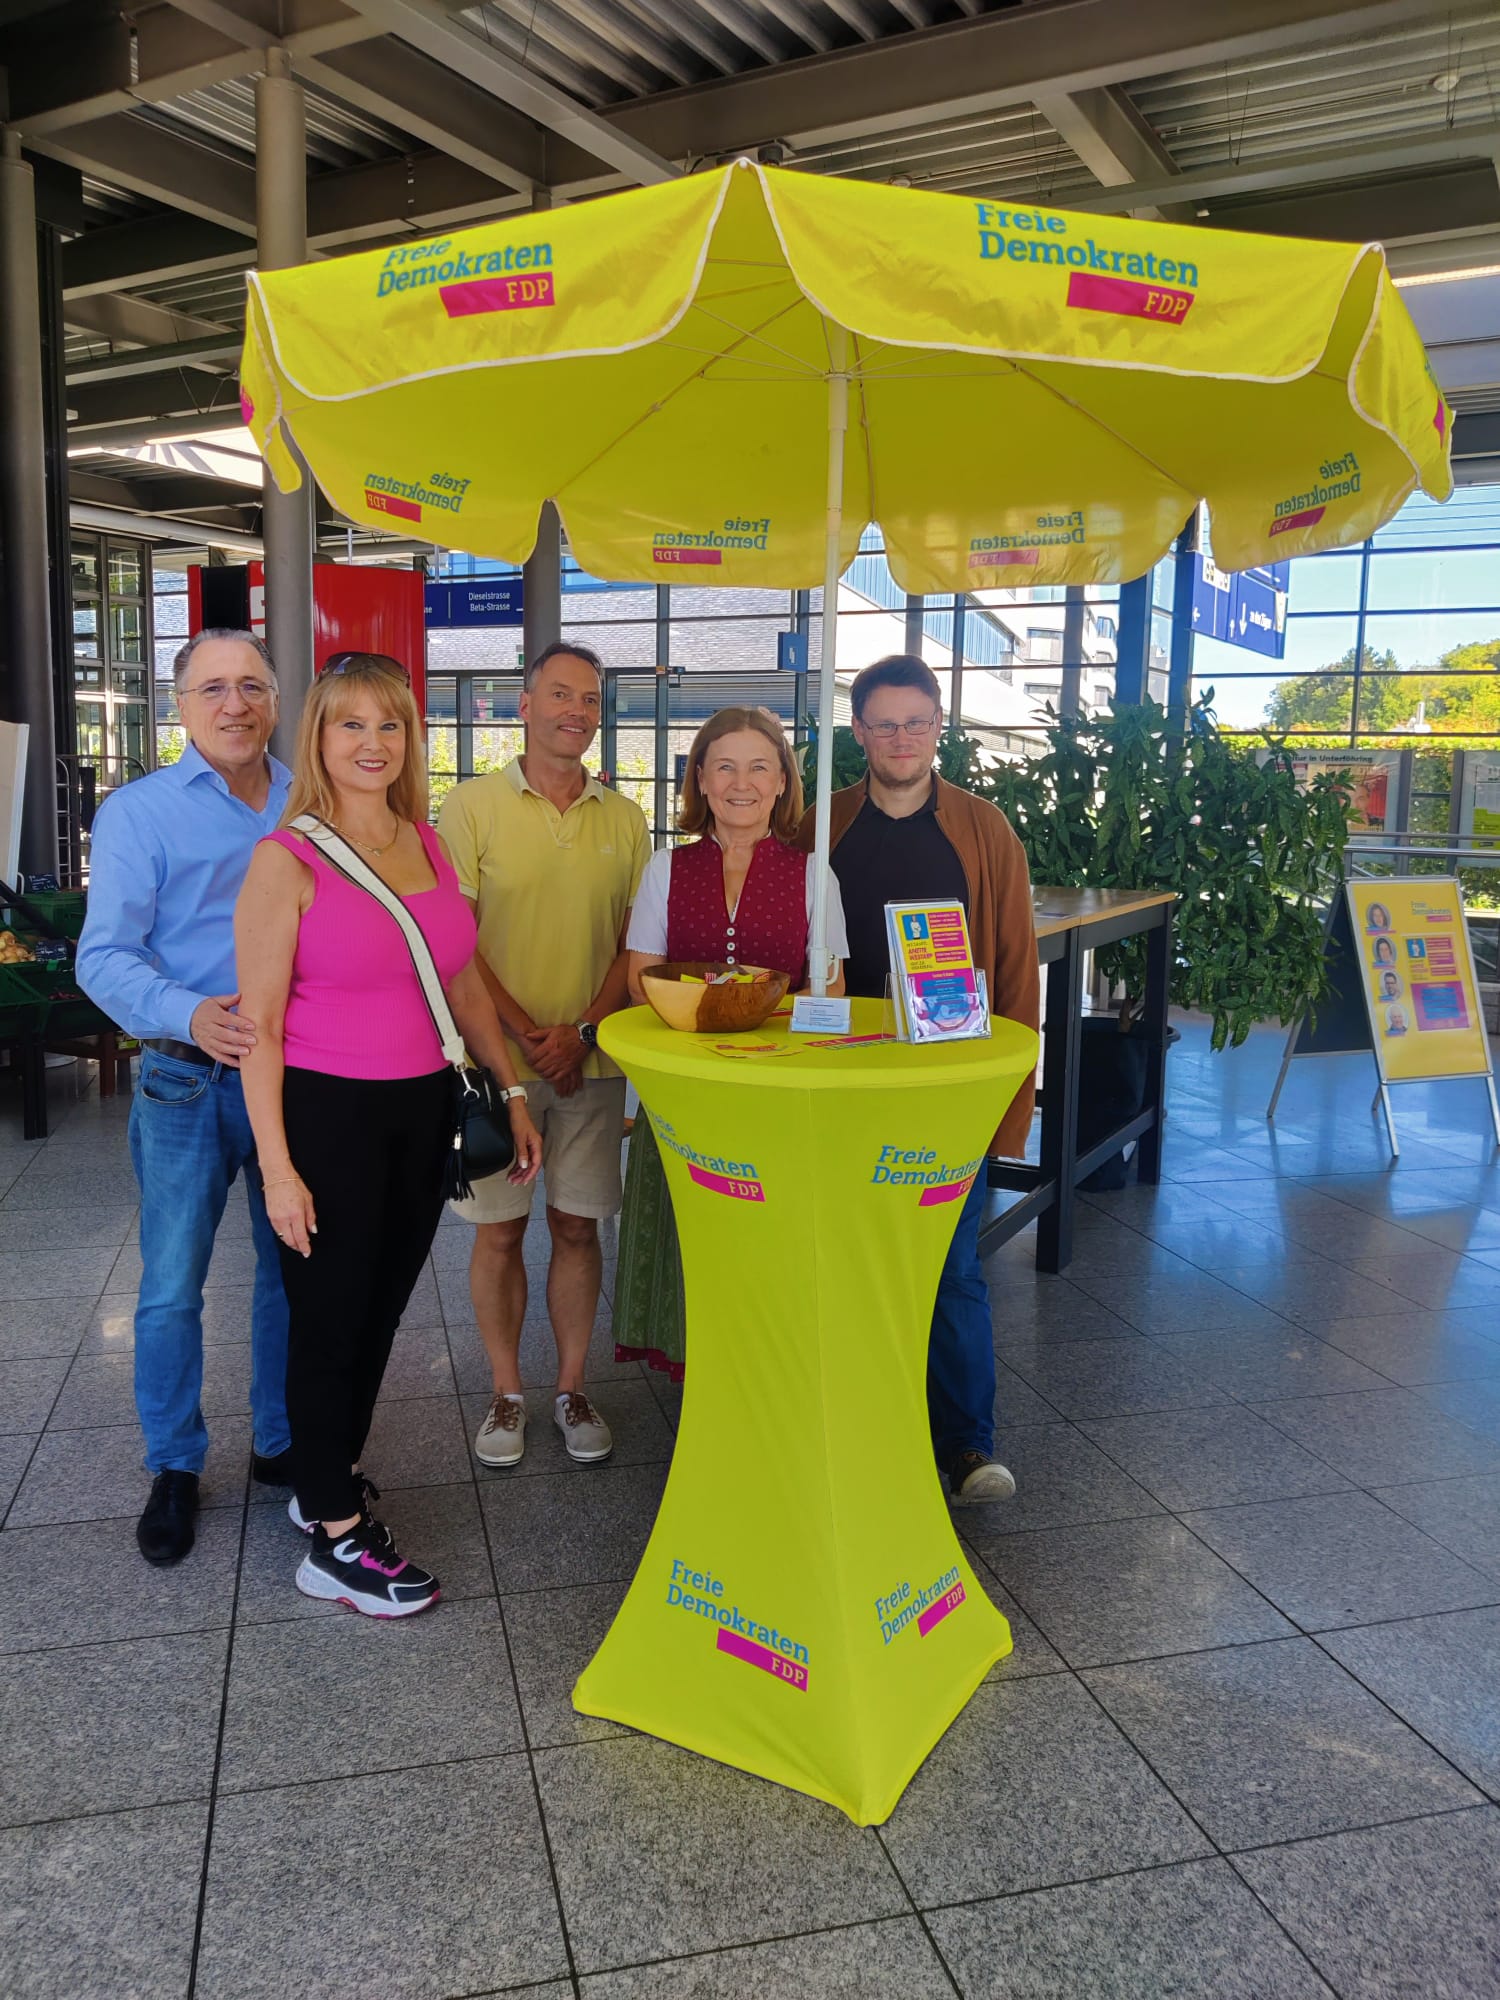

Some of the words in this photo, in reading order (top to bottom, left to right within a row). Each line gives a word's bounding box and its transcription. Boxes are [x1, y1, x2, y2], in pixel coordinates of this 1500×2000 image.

[975, 203, 1066, 233] Freie
[384, 239, 452, 268] Freie
[978, 230, 1199, 287] Demokraten
[377, 243, 553, 297] Demokraten
[505, 278, 550, 303] FDP
[1143, 291, 1188, 318] FDP
[468, 592, 511, 601] Dieselstrasse
[470, 603, 511, 612] Beta-Strasse
[1320, 755, 1373, 763] Unterföhring
[657, 1131, 759, 1179] emokraten
[878, 1145, 937, 1164] Freie
[728, 1181, 759, 1198] FDP
[670, 1559, 724, 1598] Freie
[875, 1582, 911, 1622] Freie
[880, 1565, 960, 1646] Demokraten
[945, 1586, 963, 1609] FDP
[666, 1583, 810, 1665] Demokraten
[771, 1657, 804, 1684] FDP
